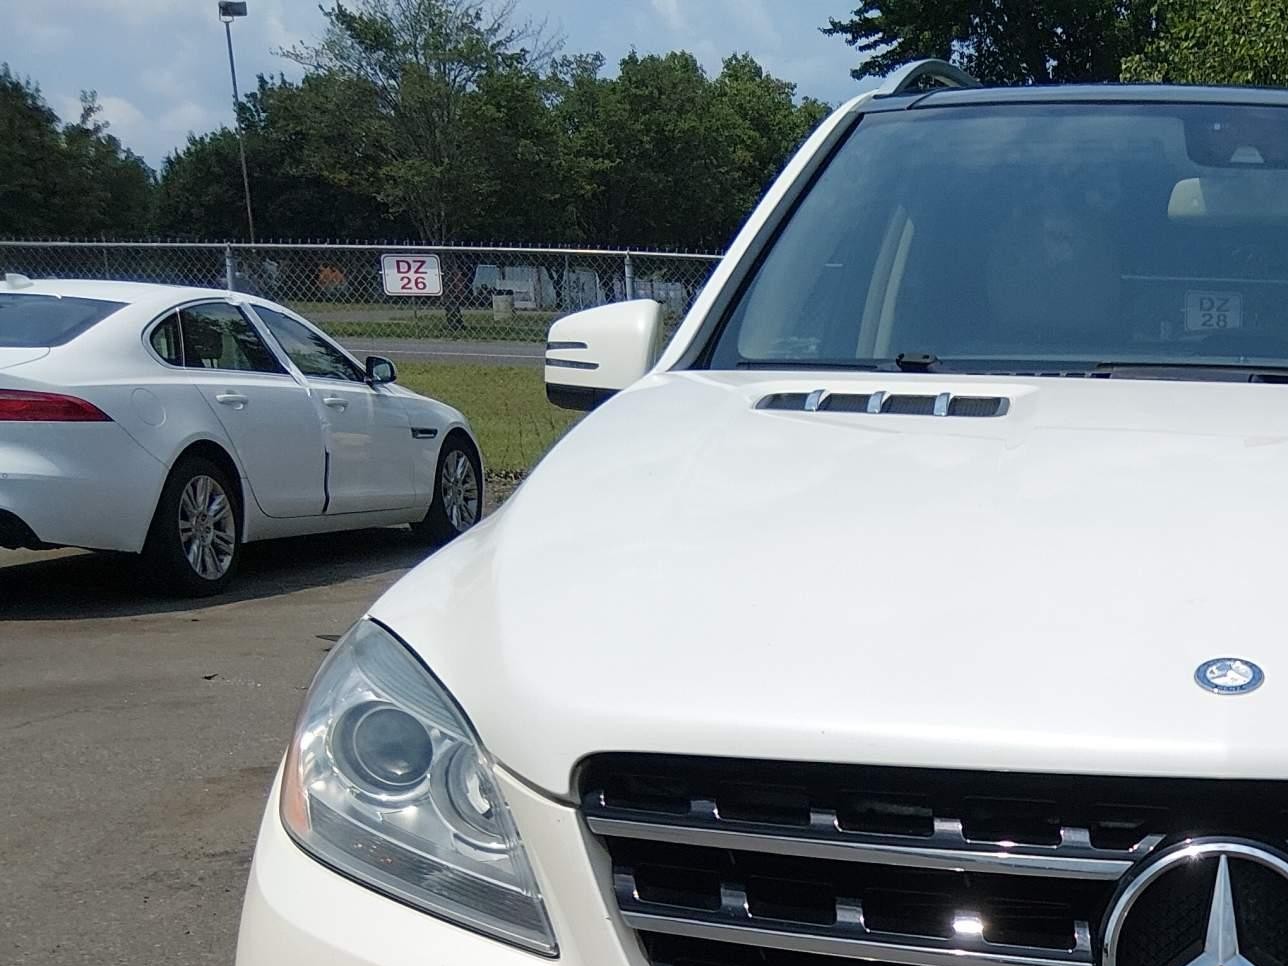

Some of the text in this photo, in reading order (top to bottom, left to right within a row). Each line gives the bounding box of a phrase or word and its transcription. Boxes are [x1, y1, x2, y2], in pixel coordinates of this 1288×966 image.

[395, 259, 428, 274] DZ
[400, 276, 427, 290] 26
[1200, 297, 1231, 312] DZ
[1201, 313, 1228, 329] 28
